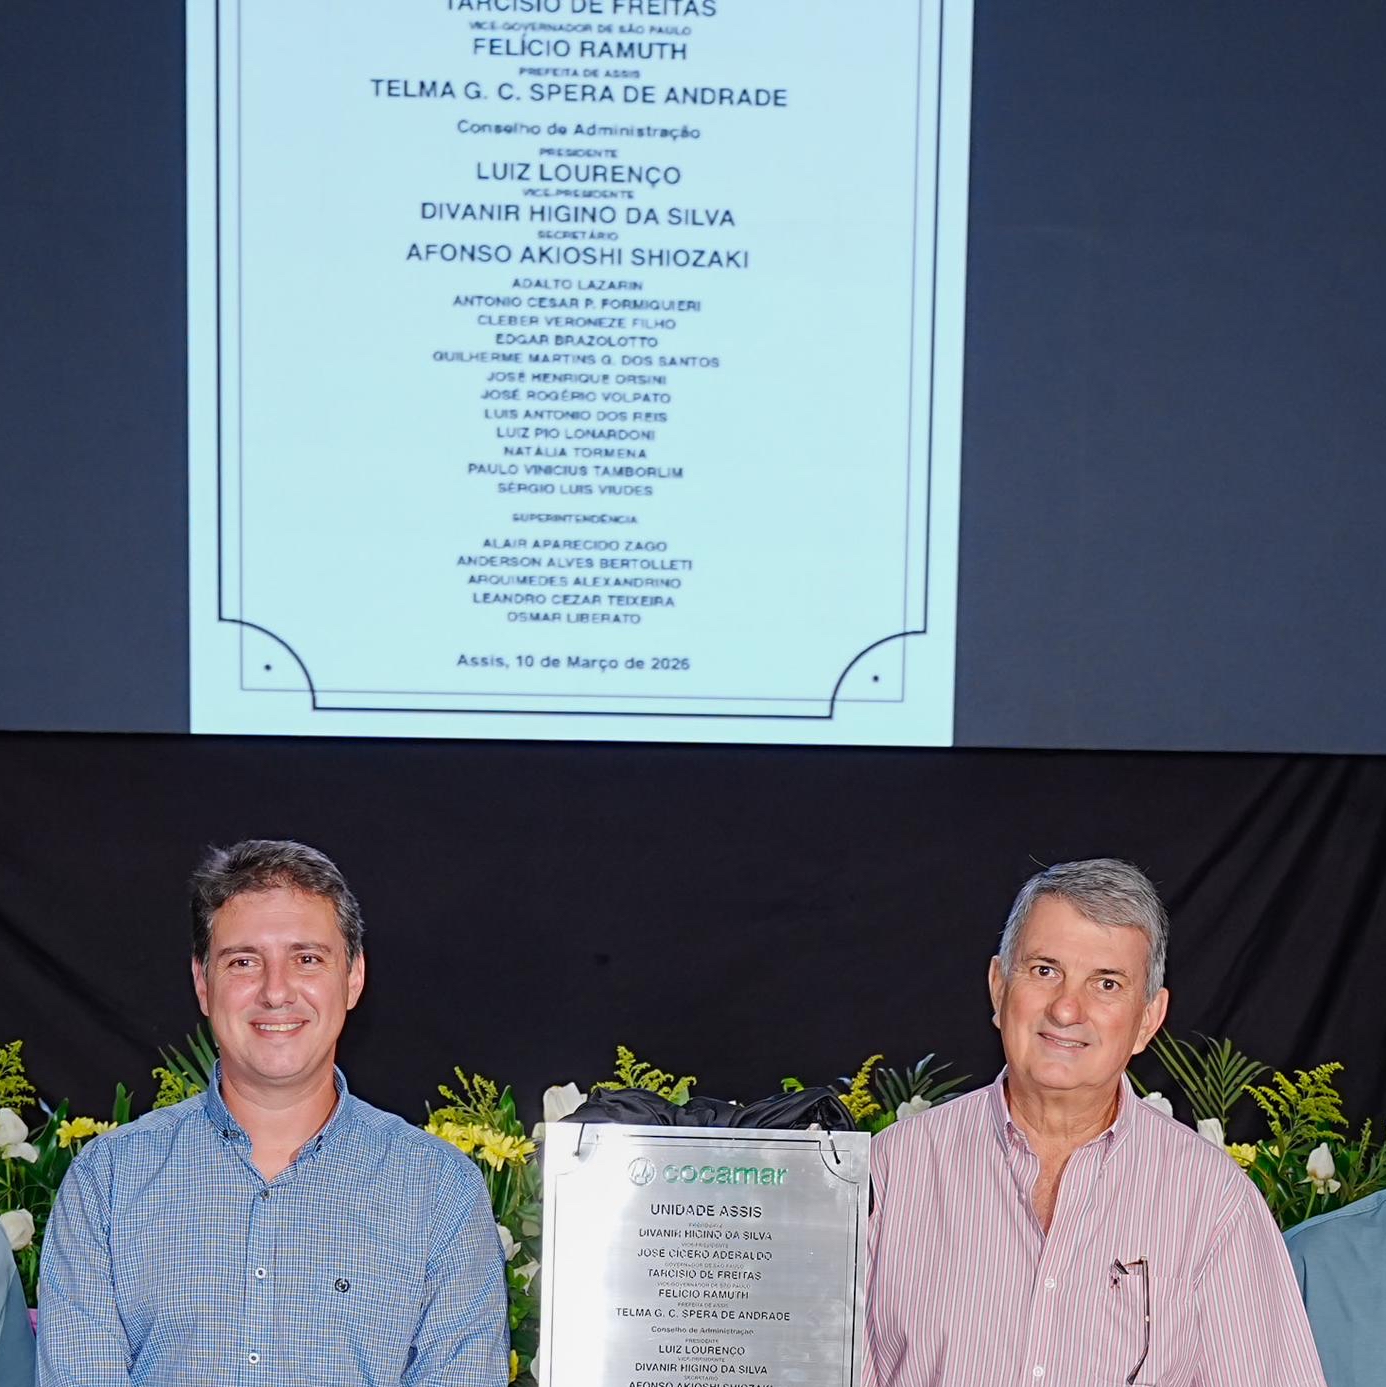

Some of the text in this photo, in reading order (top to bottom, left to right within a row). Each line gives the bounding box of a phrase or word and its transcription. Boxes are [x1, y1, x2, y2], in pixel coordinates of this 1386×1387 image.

[572, 0, 603, 14] DE
[474, 35, 686, 60] FELÍCIO RAMUTH
[371, 79, 787, 107] TELMA G. C. SPERA DE ANDRADE
[457, 119, 700, 141] Conselho de Administração
[477, 162, 681, 189] LUIZ LOURENÇO
[421, 202, 735, 226] DIVANIR HIGINO DA SILVA
[406, 242, 748, 268] AFONSO AKIOSHI SHIOZAKI
[457, 654, 690, 672] Assis, 10 de Março de 2026
[663, 1164, 788, 1186] cocamar
[651, 1204, 761, 1218] UNIDADE ASSIS
[616, 1307, 790, 1321] TELMA G. C. SPERA DE ANDRADE
[659, 1345, 745, 1356] LUIZ LOURENÇO
[636, 1363, 767, 1375] DIVANIR HIGINO DA SILVA
